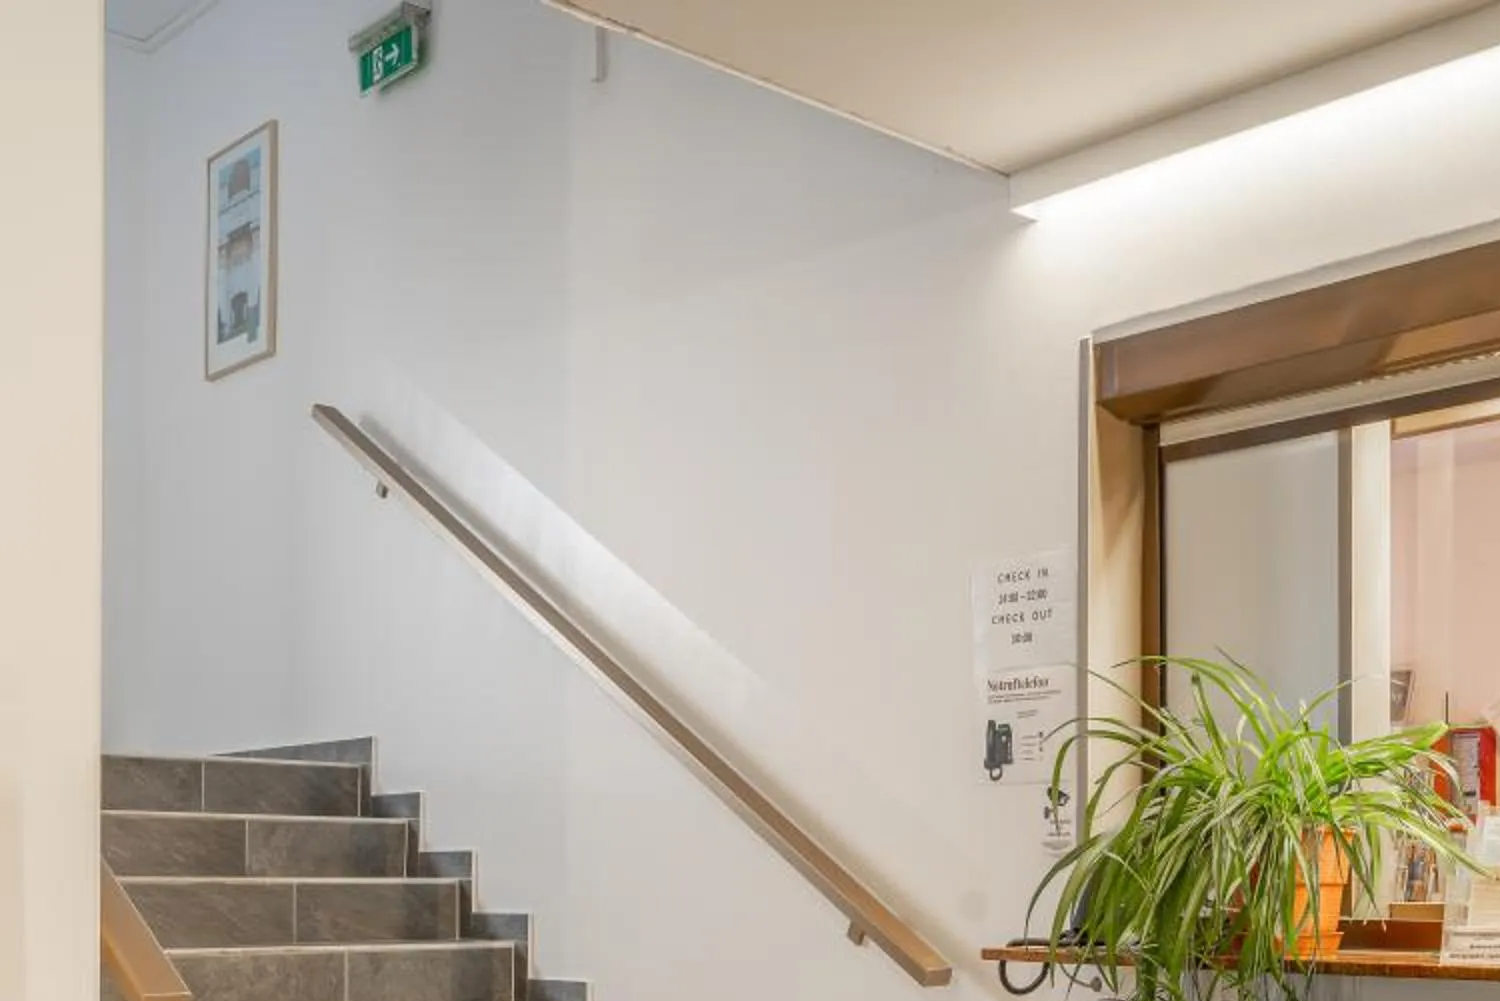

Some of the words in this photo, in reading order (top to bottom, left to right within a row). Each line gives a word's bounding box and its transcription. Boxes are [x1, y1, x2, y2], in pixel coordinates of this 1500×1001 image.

[997, 568, 1030, 584] CHECK
[1037, 567, 1049, 578] IN
[991, 612, 1025, 625] CHECK
[1032, 608, 1053, 621] OUT
